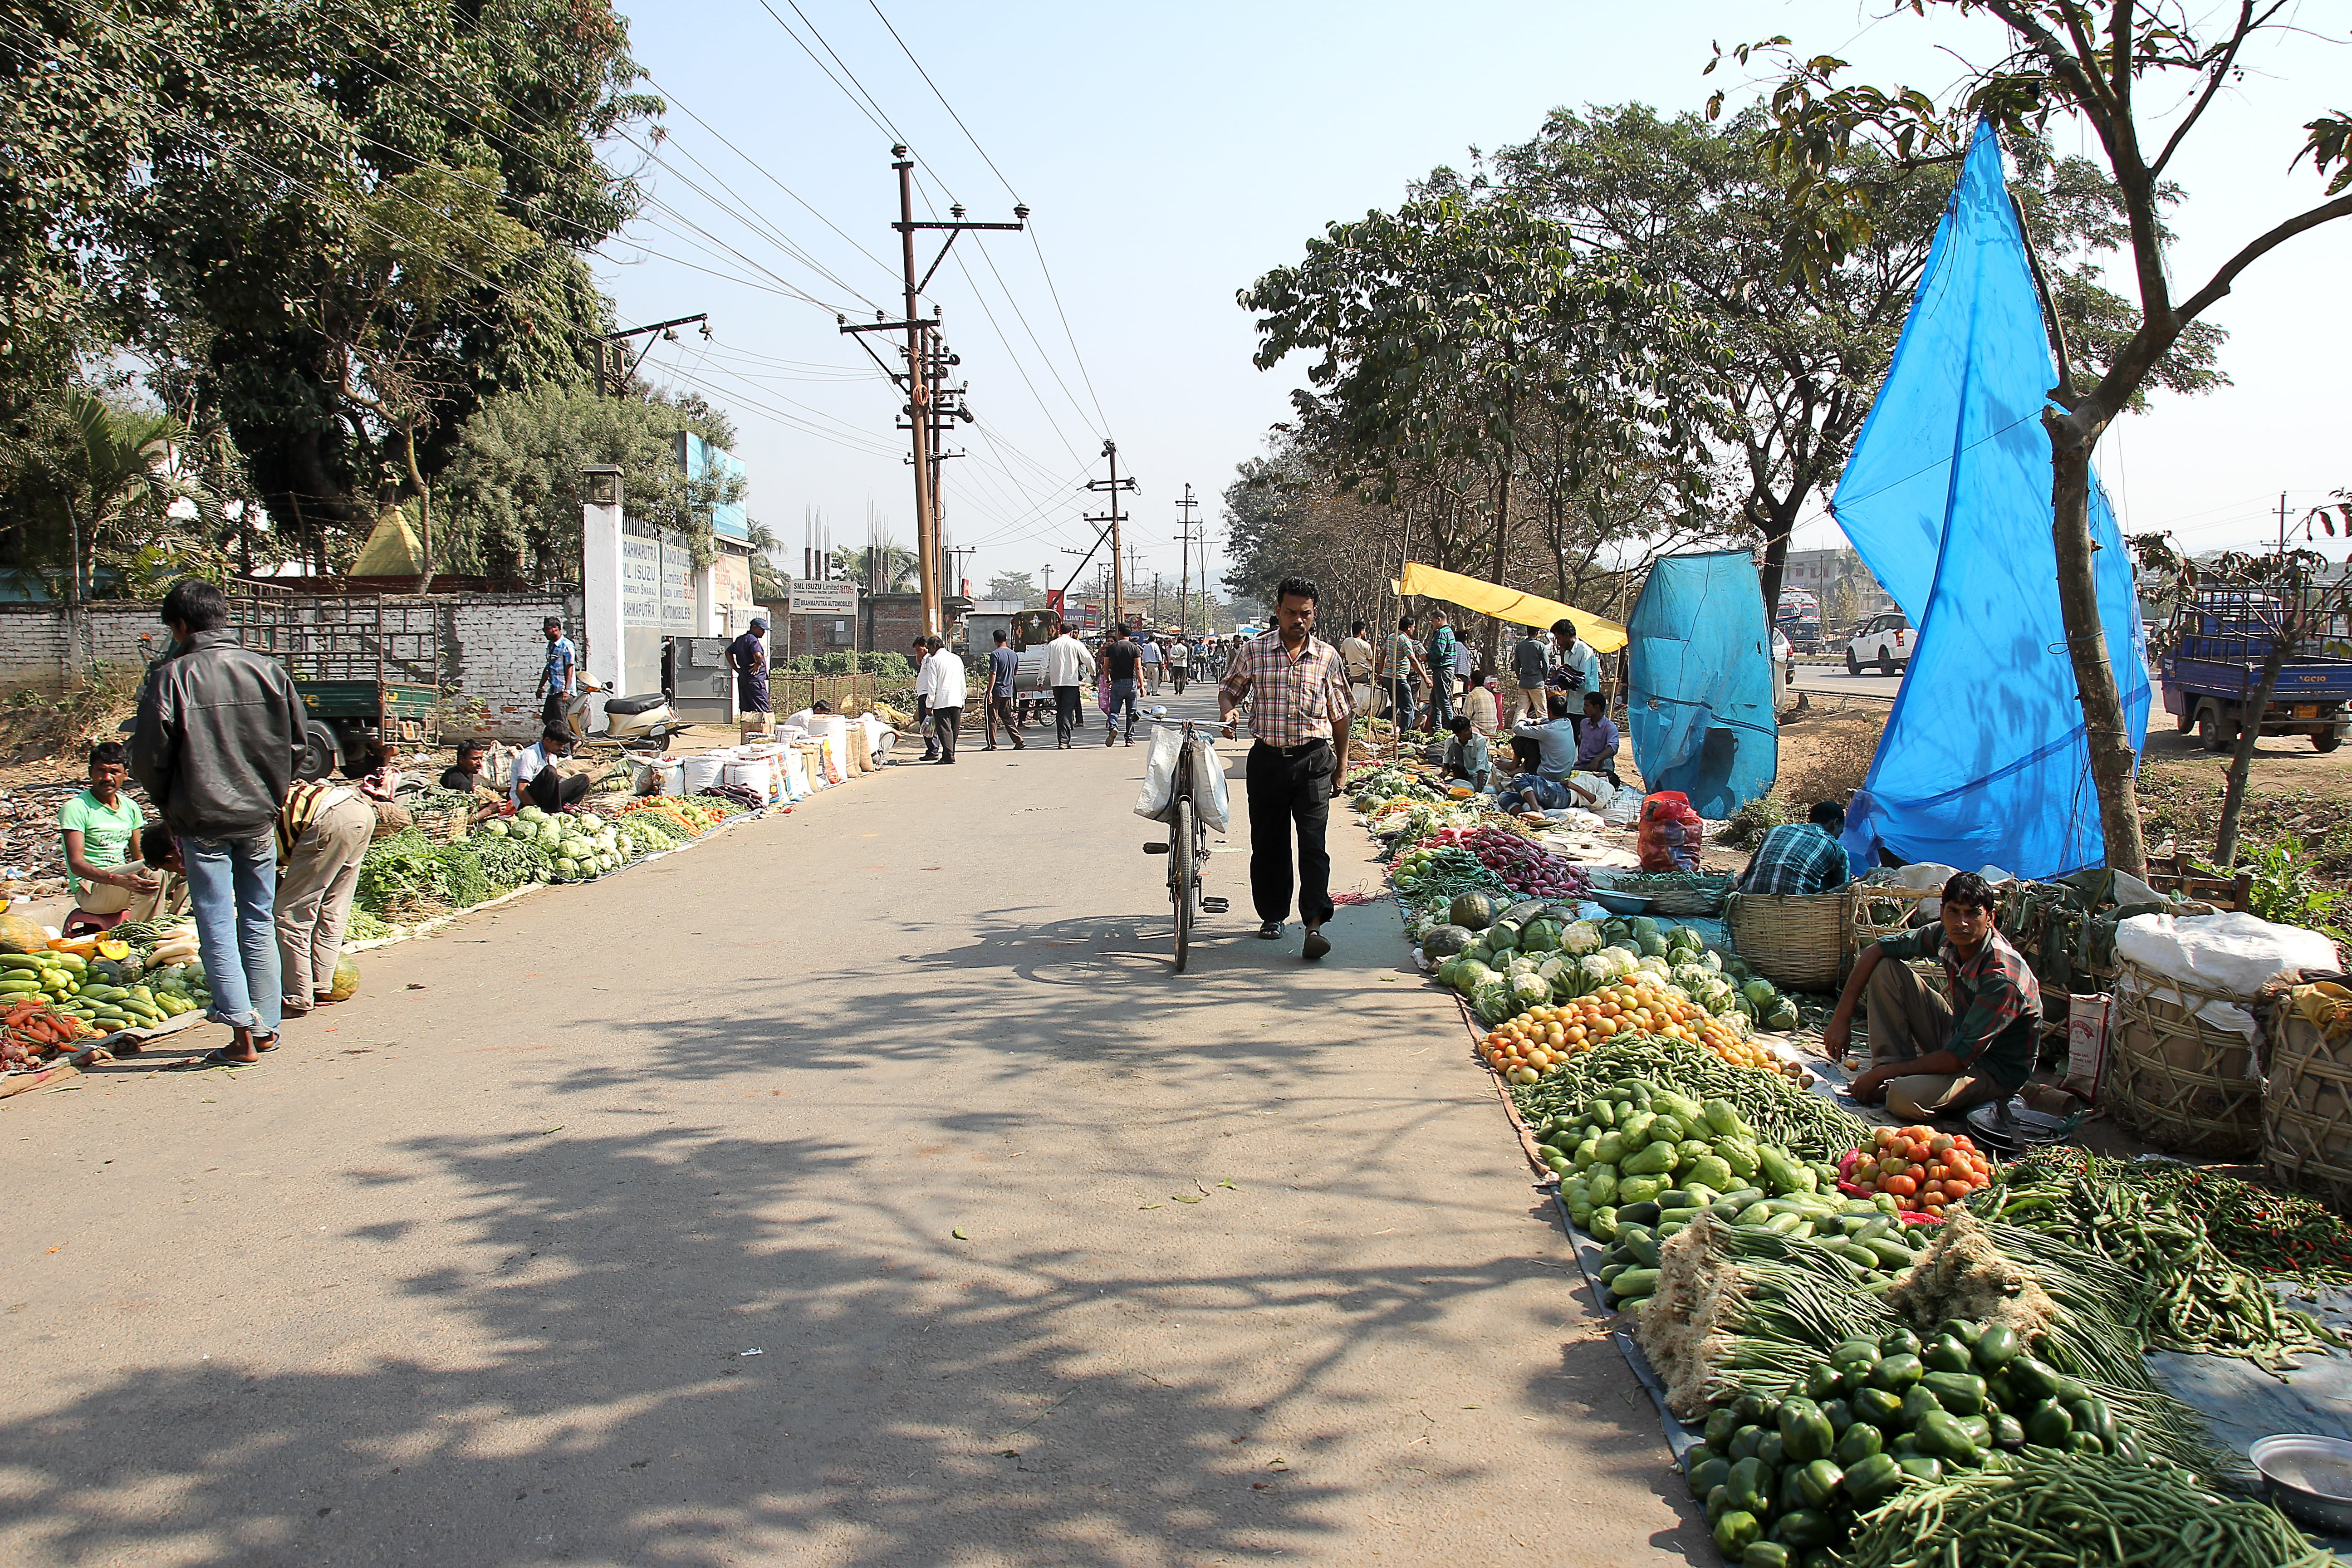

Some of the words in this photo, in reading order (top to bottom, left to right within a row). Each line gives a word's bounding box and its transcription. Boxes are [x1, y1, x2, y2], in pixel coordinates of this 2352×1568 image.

[624, 541, 657, 562] RAHMAPUTRA
[623, 563, 631, 578] ML
[635, 564, 655, 581] ISUZU
[664, 569, 681, 585] Limited
[715, 573, 730, 586] SUZU
[624, 584, 640, 593] ORMERLY
[641, 583, 656, 596] SWARAJ
[683, 589, 696, 600] ISUZU
[623, 602, 655, 618] RAHMAPUTRA
[663, 605, 691, 620] AUTOMOBILES
